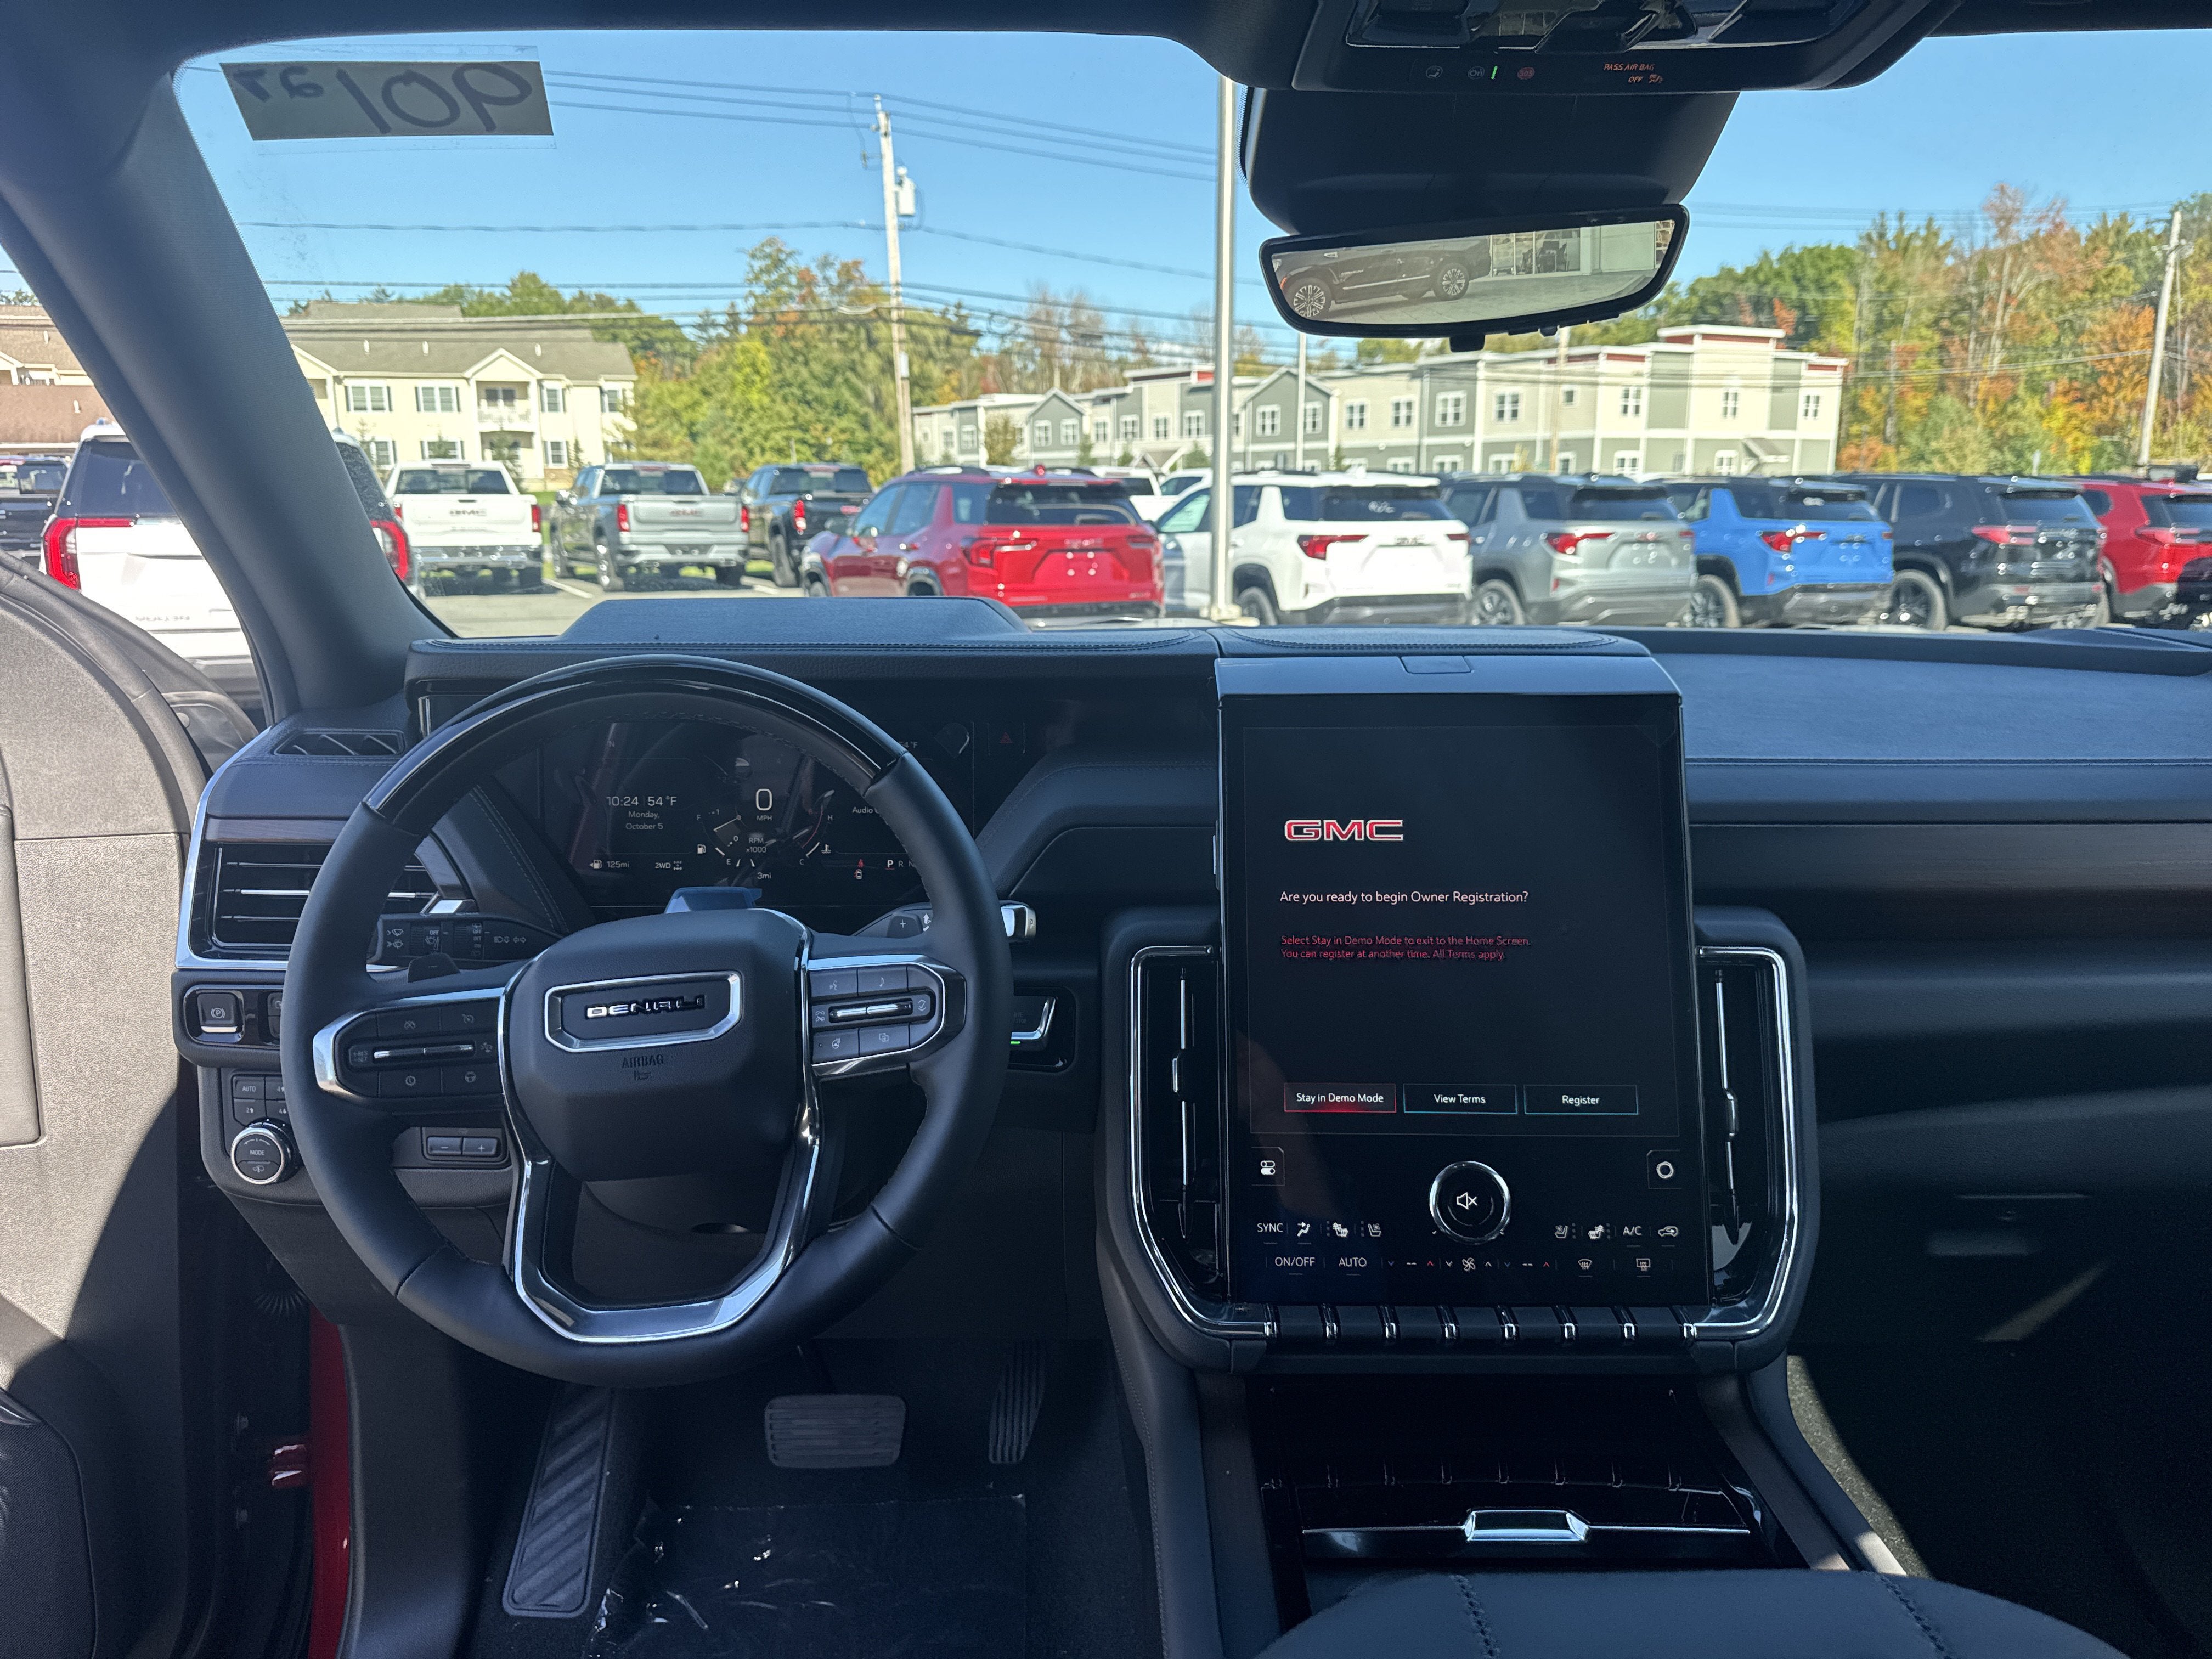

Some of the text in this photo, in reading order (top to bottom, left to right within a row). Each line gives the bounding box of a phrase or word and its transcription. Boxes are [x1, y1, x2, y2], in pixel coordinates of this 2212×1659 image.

[606, 795, 639, 806] 10:24
[647, 796, 663, 806] 54
[755, 788, 772, 811] 0
[628, 810, 660, 820] Monday,
[625, 822, 663, 831] October 5
[1284, 819, 1404, 842] GMC
[607, 861, 630, 869] 125mi
[887, 860, 894, 868] P
[1280, 891, 1529, 905] Are you ready to begin Owner Registration?
[1281, 936, 1532, 947] Select Stay in Demo Mode to exit to the Home Screen.
[1281, 950, 1299, 958] You
[1319, 950, 1355, 961] register
[1357, 950, 1365, 958] at
[1368, 949, 1404, 958] another
[1407, 950, 1430, 958] time.
[1433, 949, 1444, 958] All
[1447, 950, 1475, 958] Terms
[586, 995, 707, 1019] DENALI
[622, 1054, 664, 1069] AIRBAG
[1296, 1093, 1384, 1104] Stay in Demo Mode
[1434, 1094, 1486, 1103] View Terms
[1562, 1095, 1600, 1107] Register
[1257, 1223, 1283, 1233] SYNC
[1623, 1226, 1642, 1235] A/C
[1274, 1257, 1316, 1267] ON/OFF
[1339, 1257, 1367, 1267] AUTO
